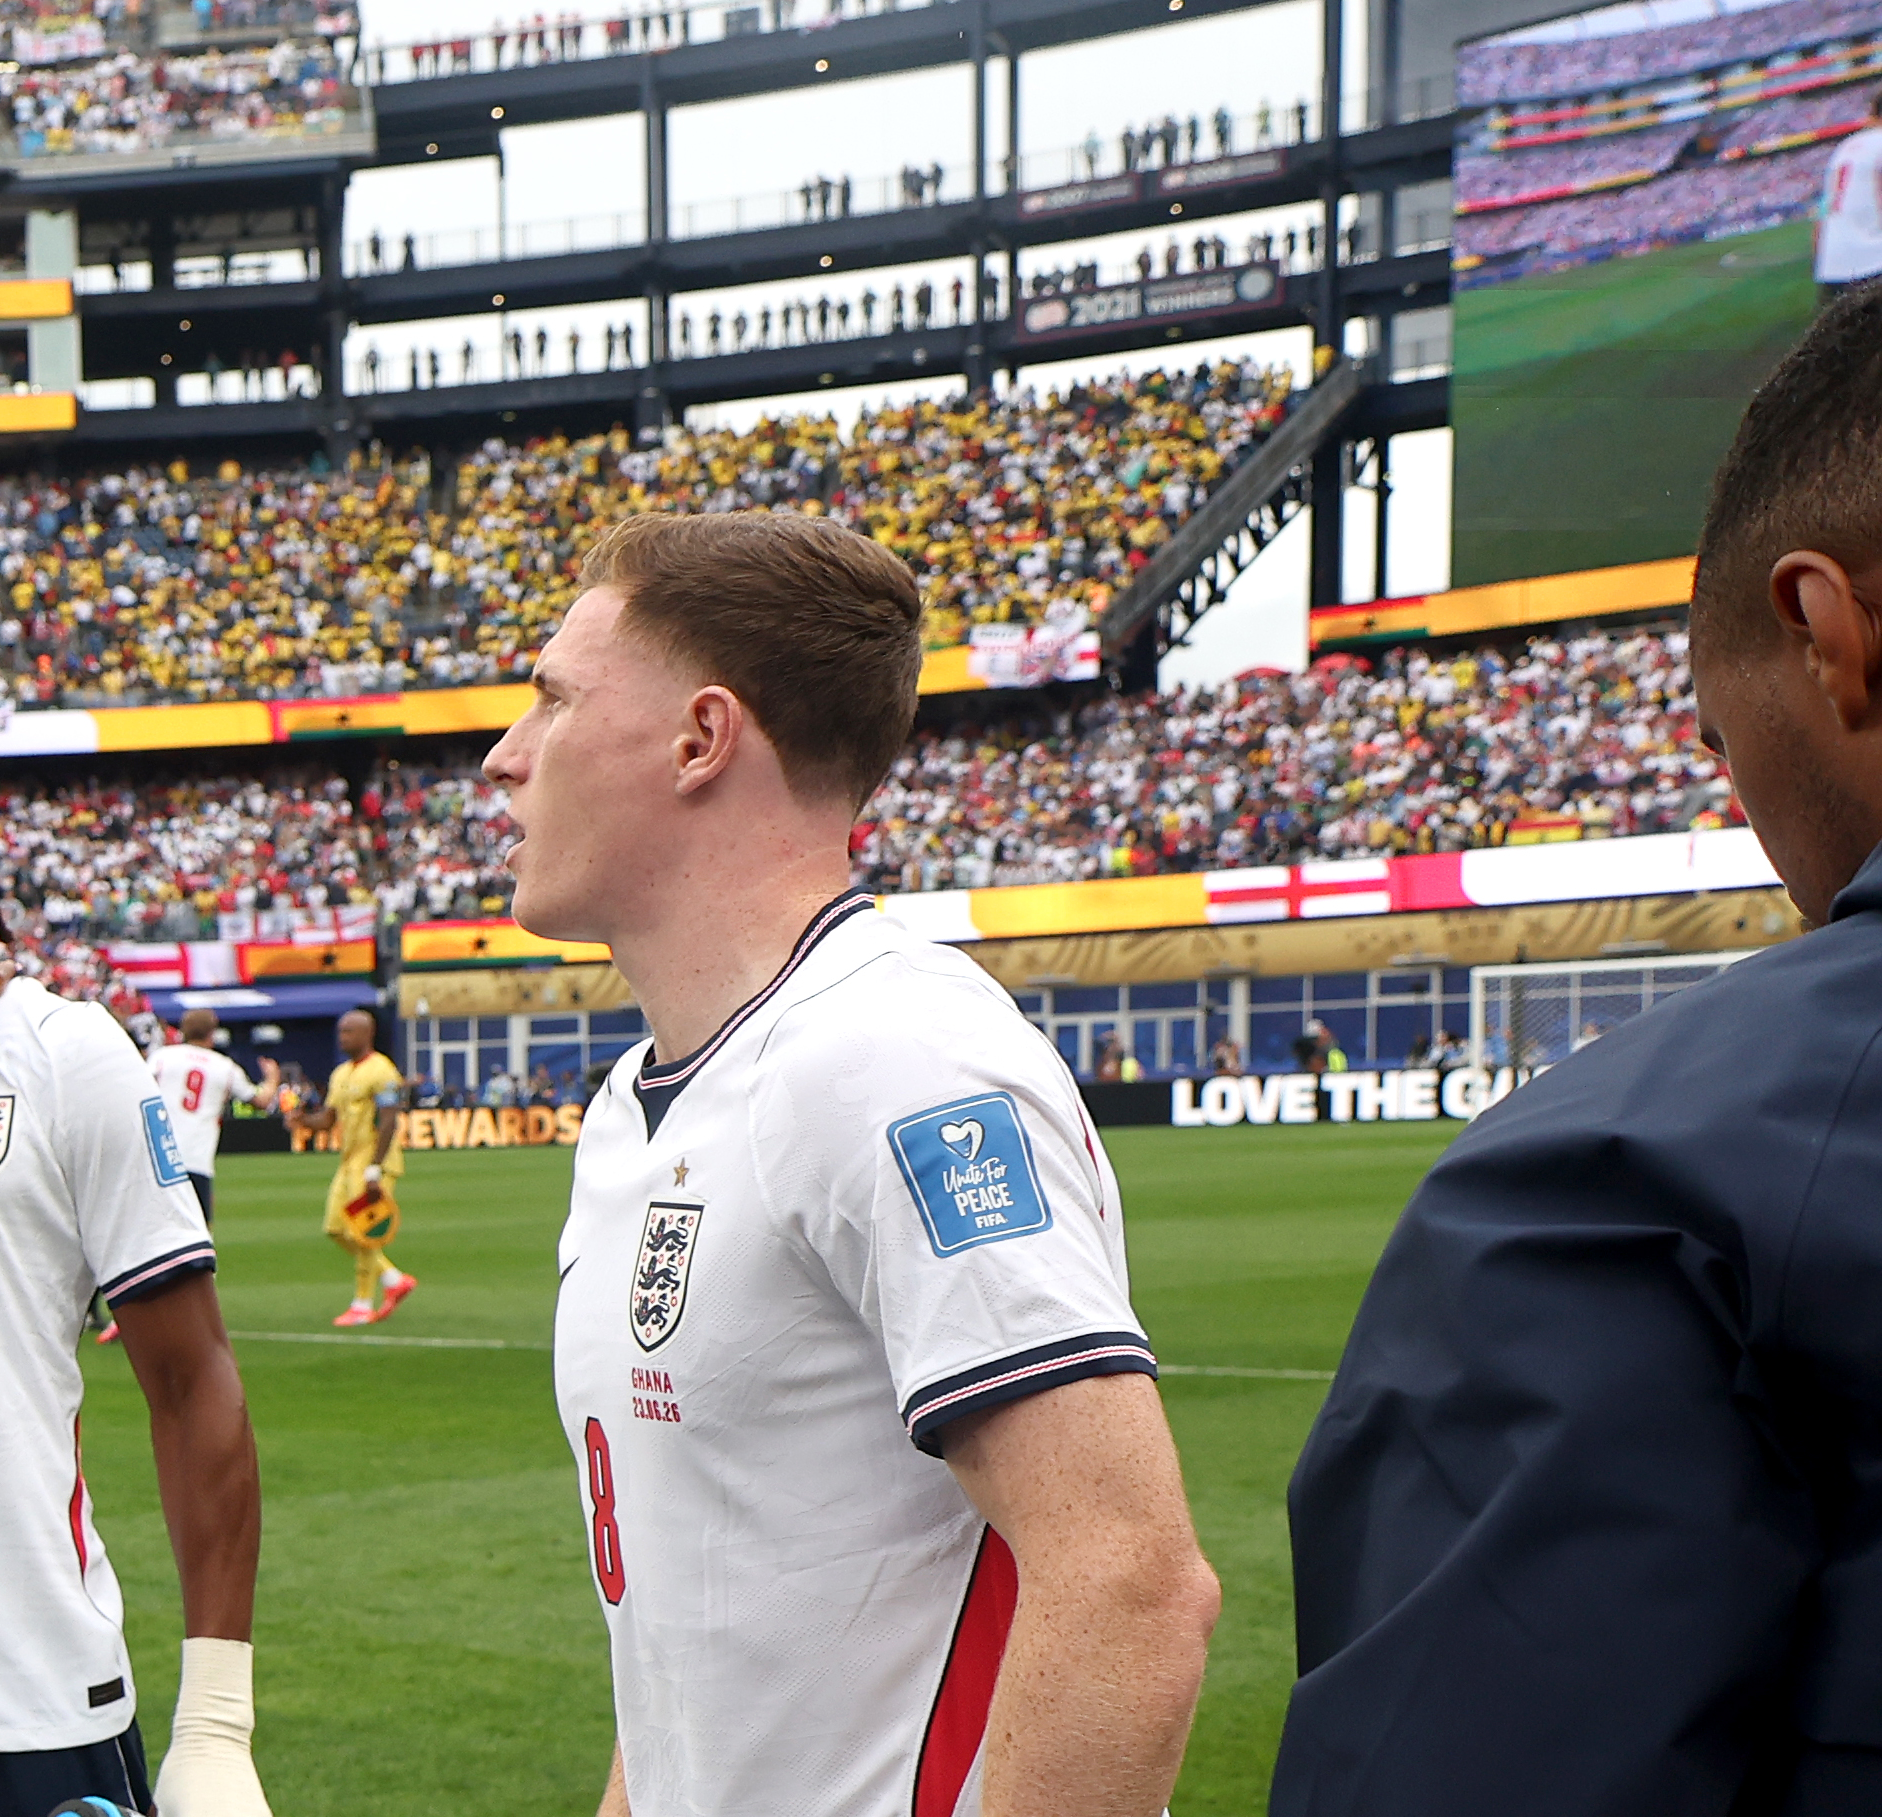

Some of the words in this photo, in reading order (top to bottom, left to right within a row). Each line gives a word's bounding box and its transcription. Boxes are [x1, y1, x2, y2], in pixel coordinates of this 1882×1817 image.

[1070, 287, 1143, 327] 2021
[183, 1070, 205, 1112] 9
[1170, 1073, 1320, 1128] LOVE
[1321, 1068, 1440, 1122] THE
[942, 1164, 984, 1193] Unite
[981, 1157, 1008, 1184] For
[953, 1182, 1014, 1217] PEACE
[974, 1212, 1008, 1229] FIFA
[631, 1366, 674, 1394] GHANA
[632, 1395, 681, 1423] 23.06.26
[585, 1415, 626, 1606] 8
